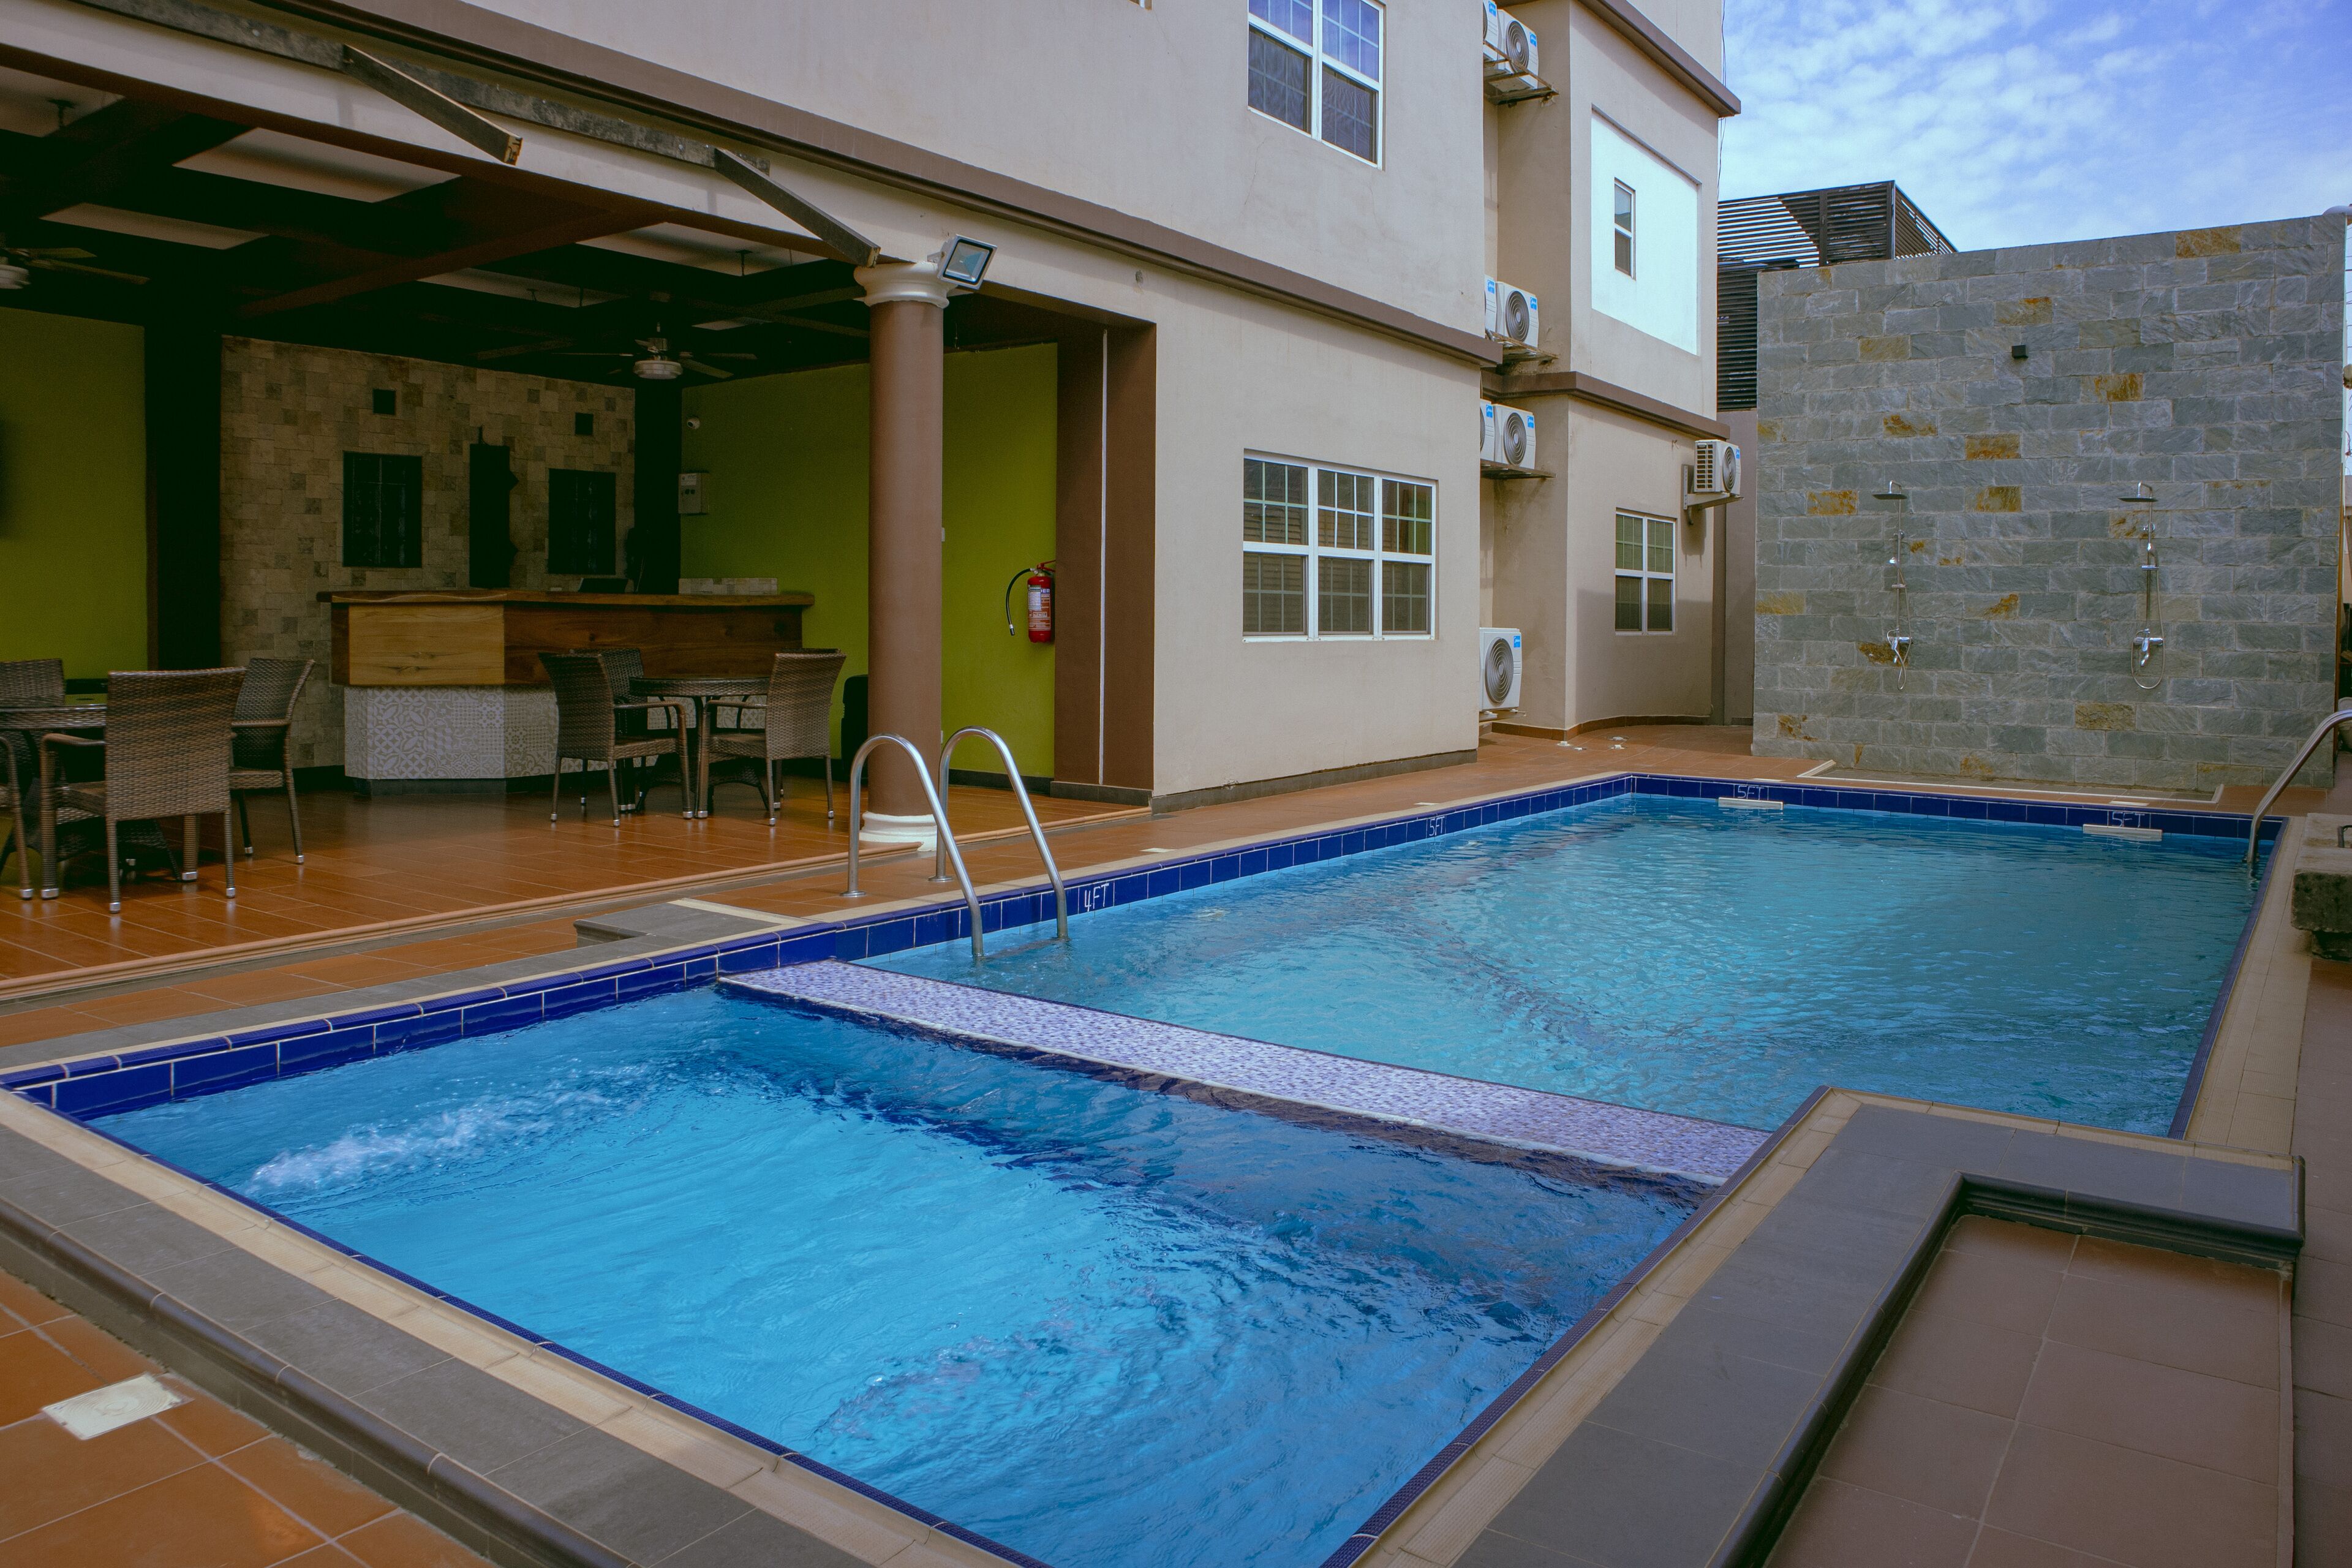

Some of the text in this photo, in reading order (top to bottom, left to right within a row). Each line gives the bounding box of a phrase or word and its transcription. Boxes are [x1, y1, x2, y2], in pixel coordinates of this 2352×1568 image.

[1737, 785, 1765, 800] 5FT
[1429, 816, 1445, 836] 5FT
[2112, 812, 2145, 827] 5FT
[1084, 883, 1109, 912] 4FT
